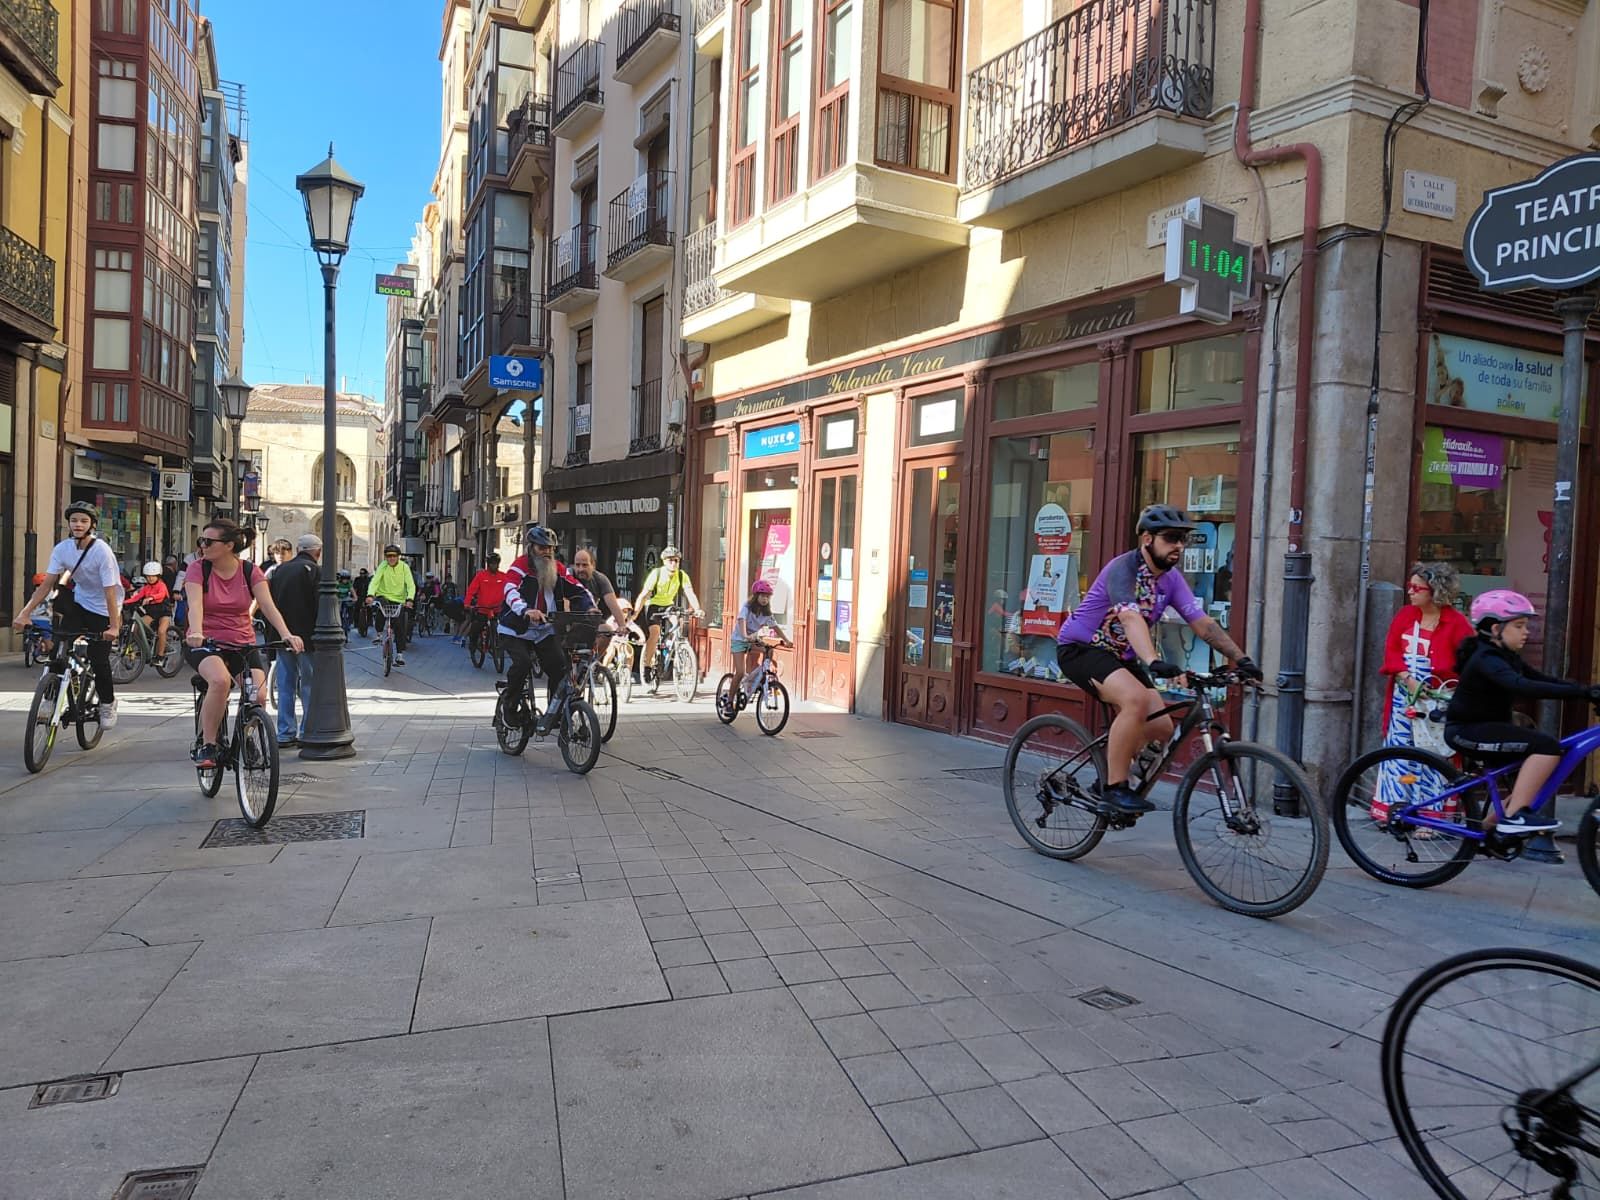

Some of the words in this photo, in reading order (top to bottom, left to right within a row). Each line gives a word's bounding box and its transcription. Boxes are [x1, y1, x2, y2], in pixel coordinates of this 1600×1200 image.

[1423, 180, 1445, 191] CALLE
[1426, 191, 1435, 199] DE
[1188, 239, 1244, 282] 11:04
[378, 286, 411, 297] BOLSOS
[1458, 351, 1471, 363] Un
[1472, 354, 1498, 369] aliado
[1499, 361, 1514, 372] para
[1514, 357, 1524, 373] la
[1525, 361, 1553, 377] salud
[493, 377, 537, 389] Samsonite
[733, 392, 786, 418] Farmacia
[827, 363, 894, 394] Yolanda
[902, 352, 946, 377] Vara
[1478, 370, 1490, 384] de
[1491, 374, 1511, 388] toda
[1513, 378, 1523, 389] su
[1524, 377, 1552, 393] familia
[761, 433, 786, 446] NUXE
[632, 497, 660, 513] WORLD
[615, 561, 633, 575] GUSTA
